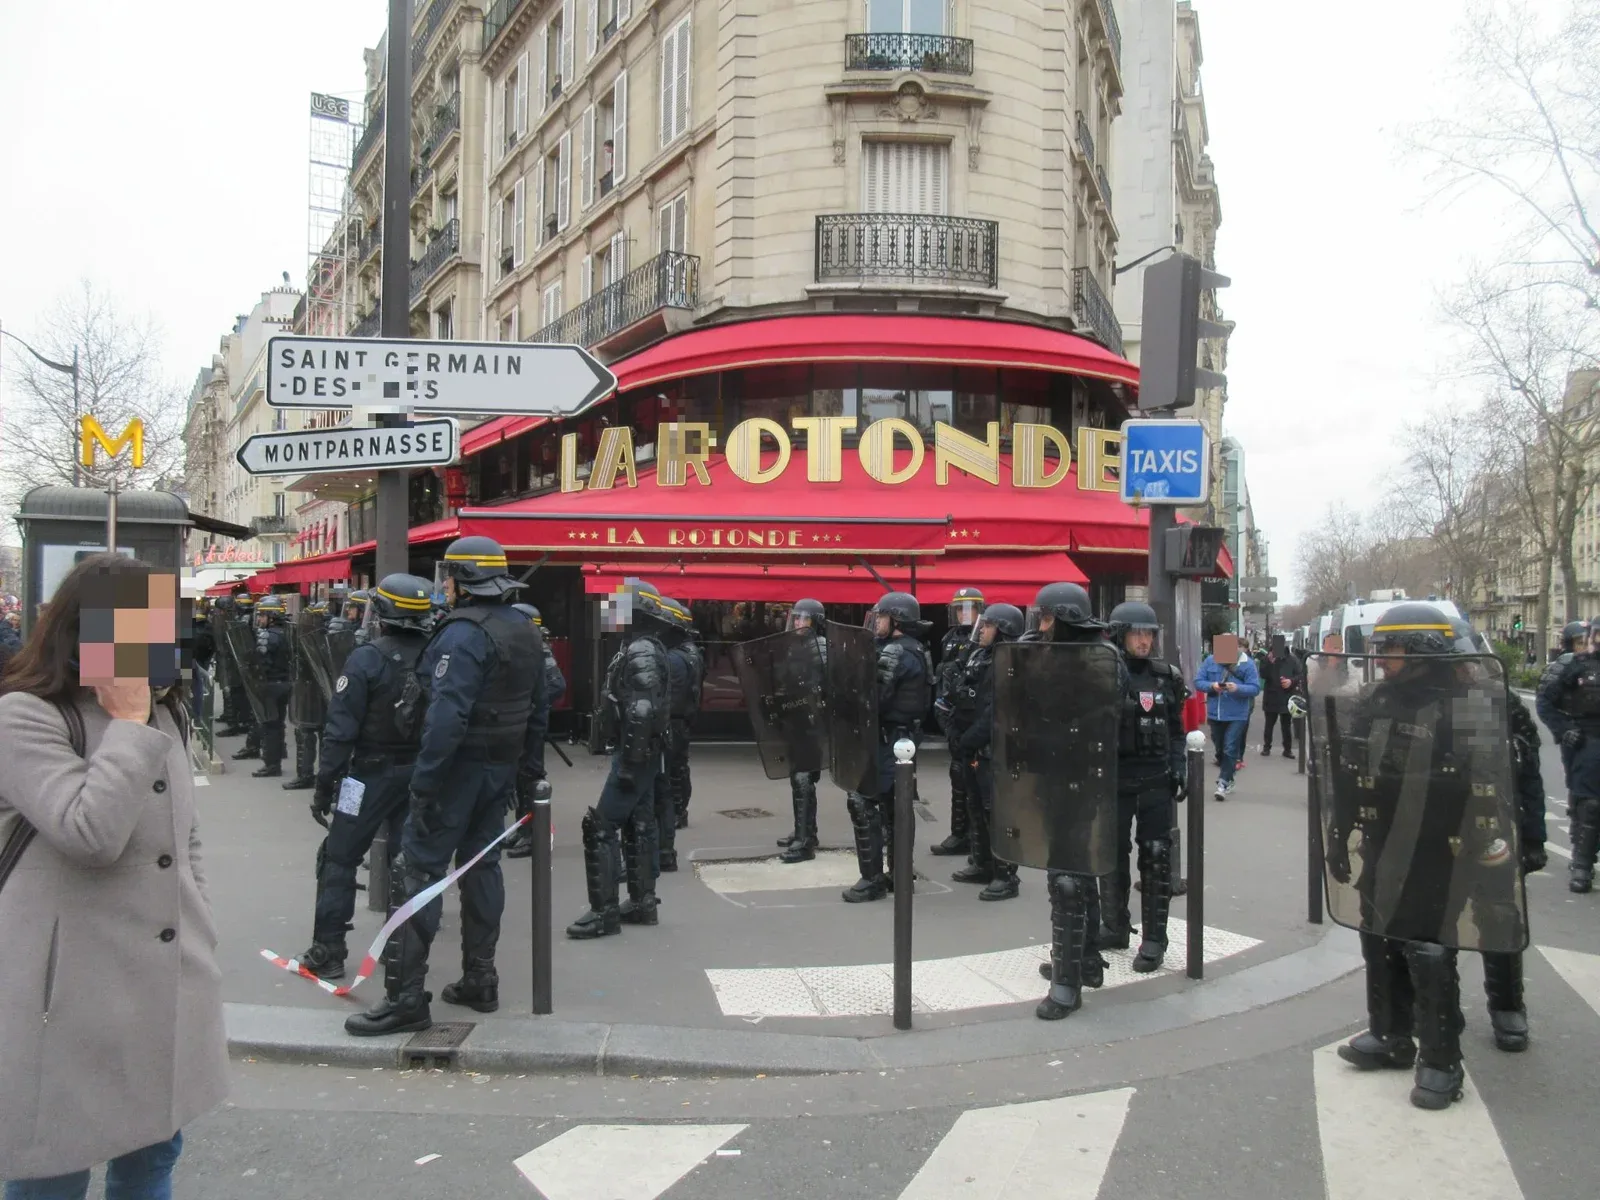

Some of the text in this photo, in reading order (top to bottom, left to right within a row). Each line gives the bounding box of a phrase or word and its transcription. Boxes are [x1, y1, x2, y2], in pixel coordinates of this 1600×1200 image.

[312, 95, 349, 118] UGC
[281, 349, 368, 370] SAINT
[280, 375, 439, 400] -DESS
[81, 413, 143, 469] M
[265, 431, 444, 464] MONTPARNASSE
[561, 417, 1120, 493] LA ROTONDE
[1130, 449, 1198, 474] TAXIS
[607, 527, 803, 547] LA ROTONDE
